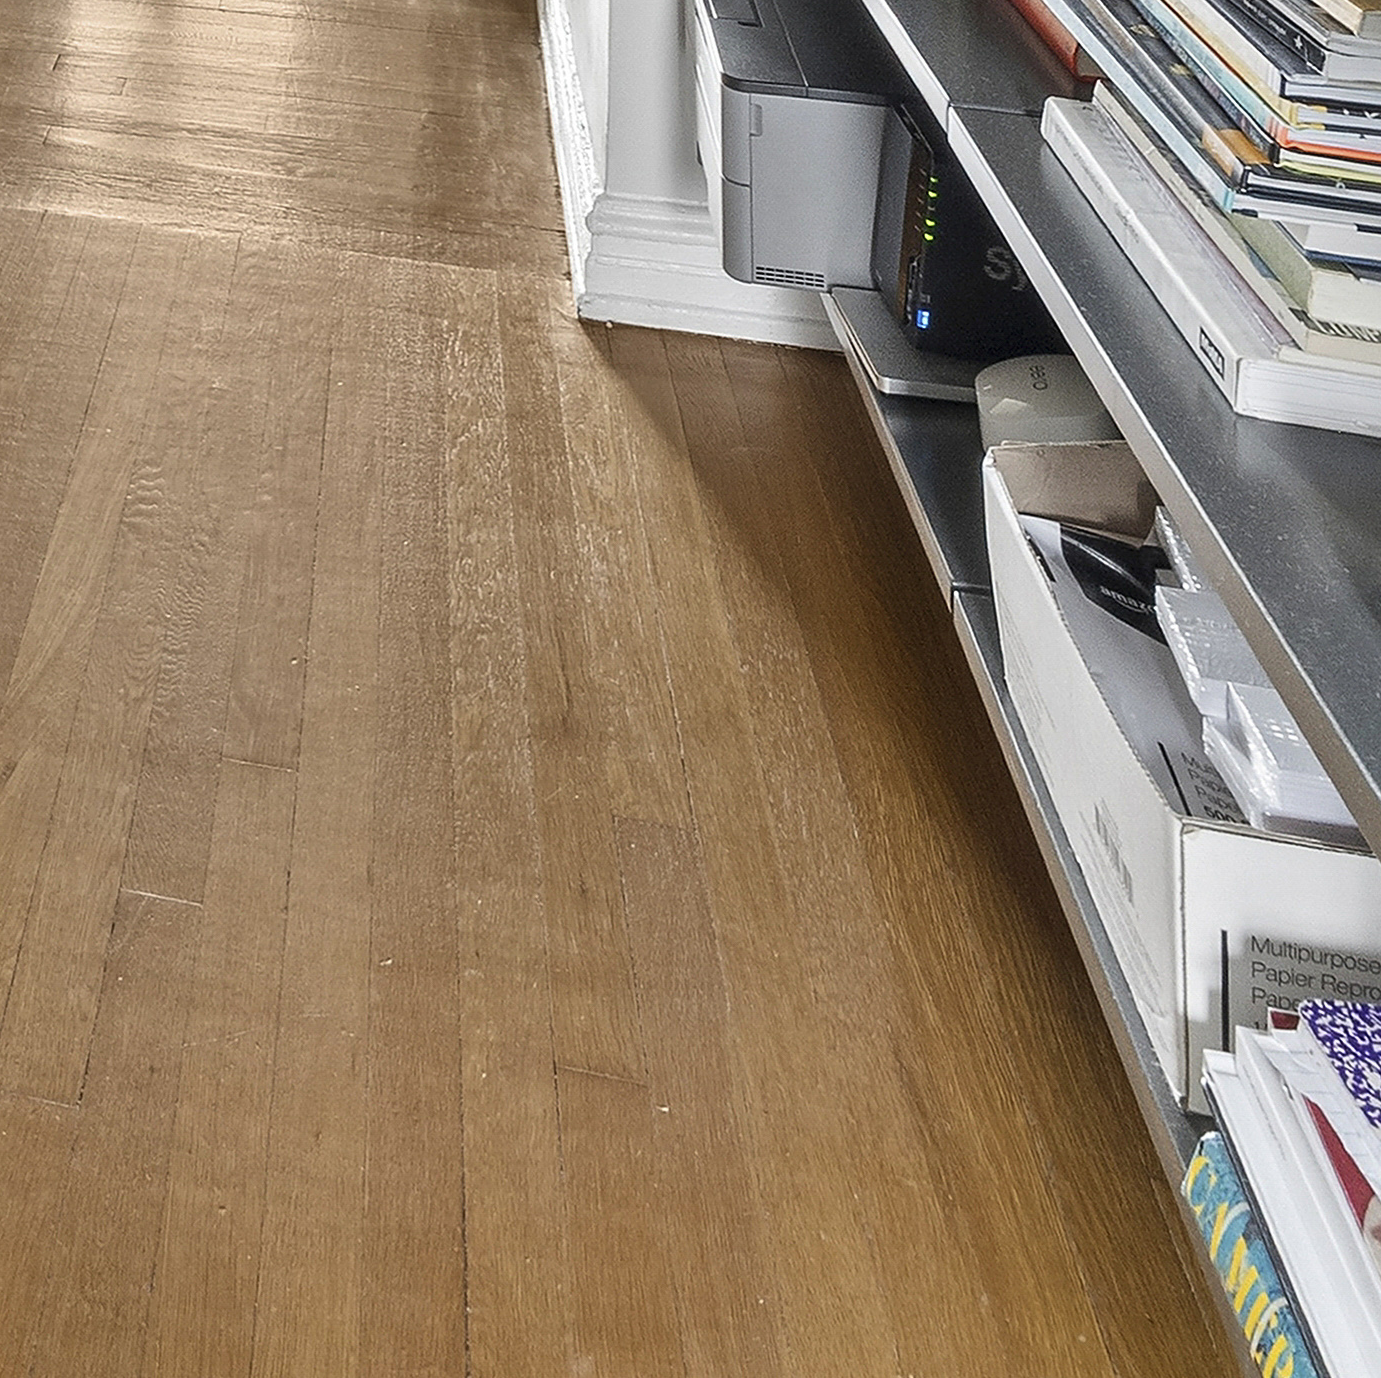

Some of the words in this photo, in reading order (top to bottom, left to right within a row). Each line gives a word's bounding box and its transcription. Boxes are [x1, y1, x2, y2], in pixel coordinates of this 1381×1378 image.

[1099, 586, 1156, 613] amazo
[1250, 934, 1381, 973] Multipurpose
[1251, 960, 1315, 989] Papier
